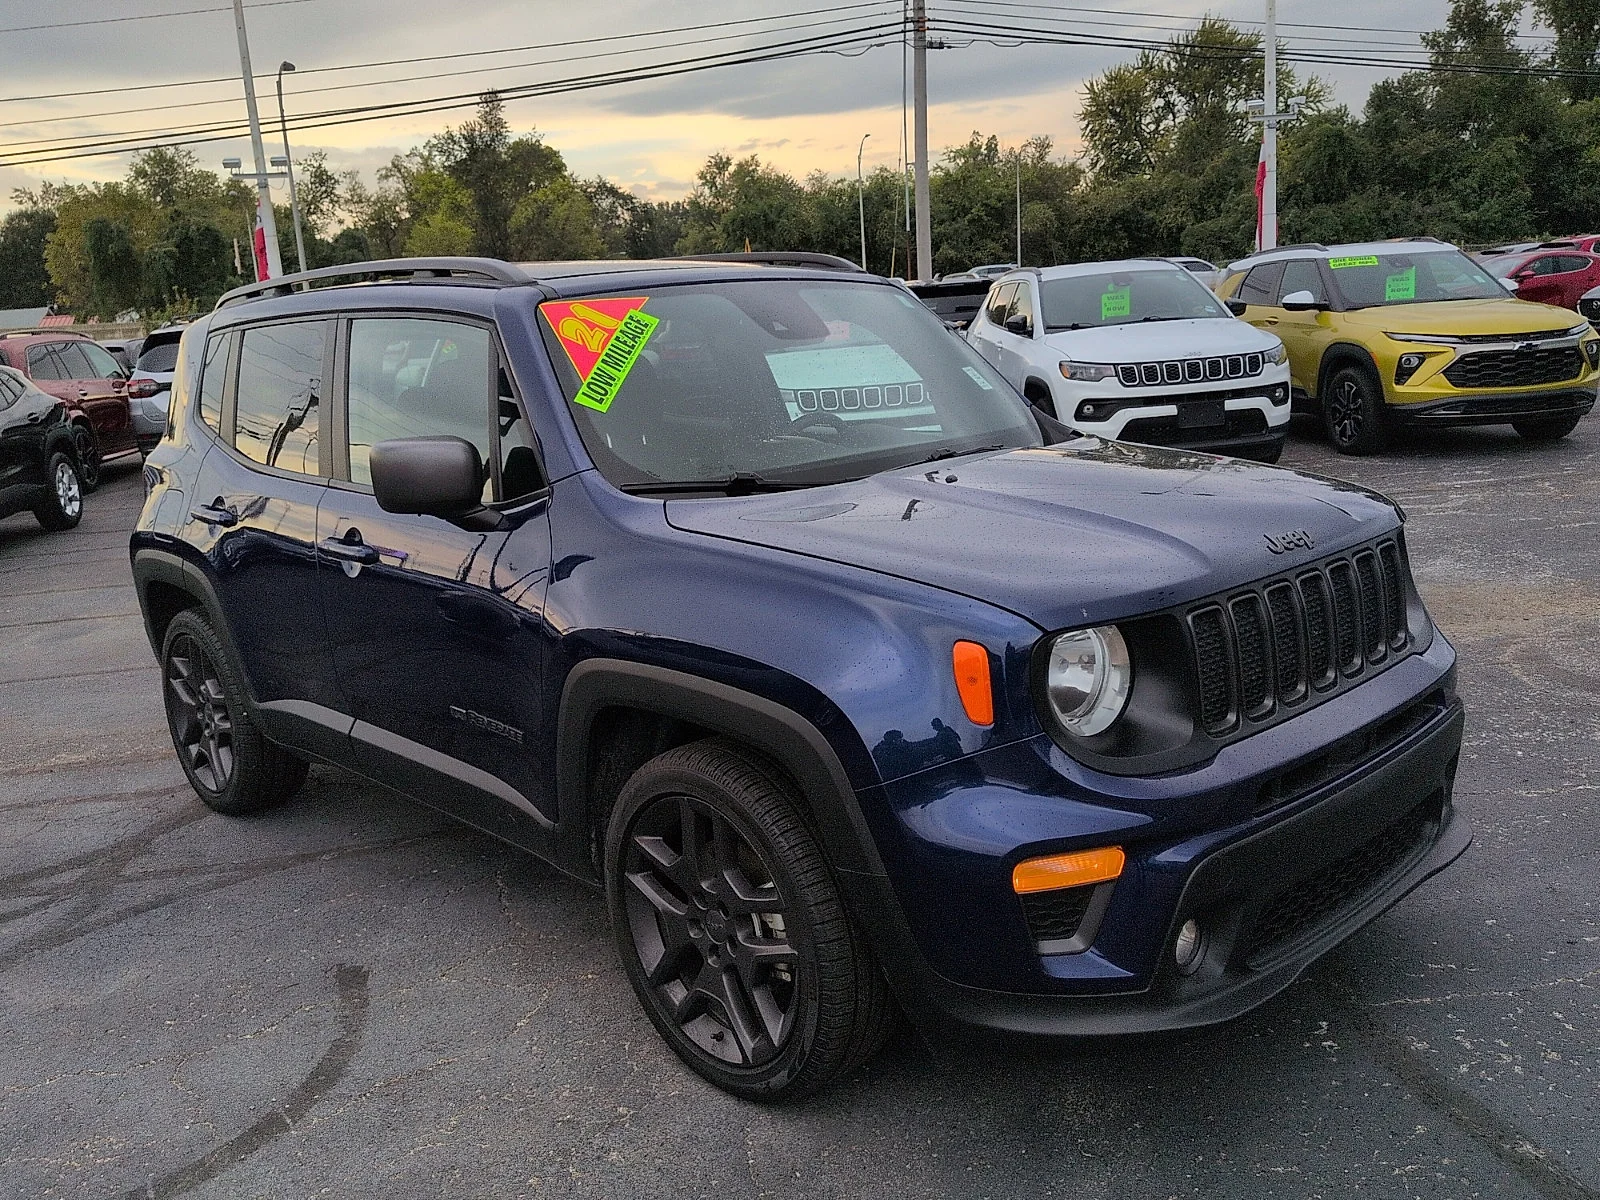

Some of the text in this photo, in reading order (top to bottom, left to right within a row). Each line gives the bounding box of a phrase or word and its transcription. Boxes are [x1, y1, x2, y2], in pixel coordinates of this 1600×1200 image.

[559, 303, 622, 353] 21
[581, 315, 650, 405] LOW MILEAGE
[1263, 528, 1314, 555] Jeep
